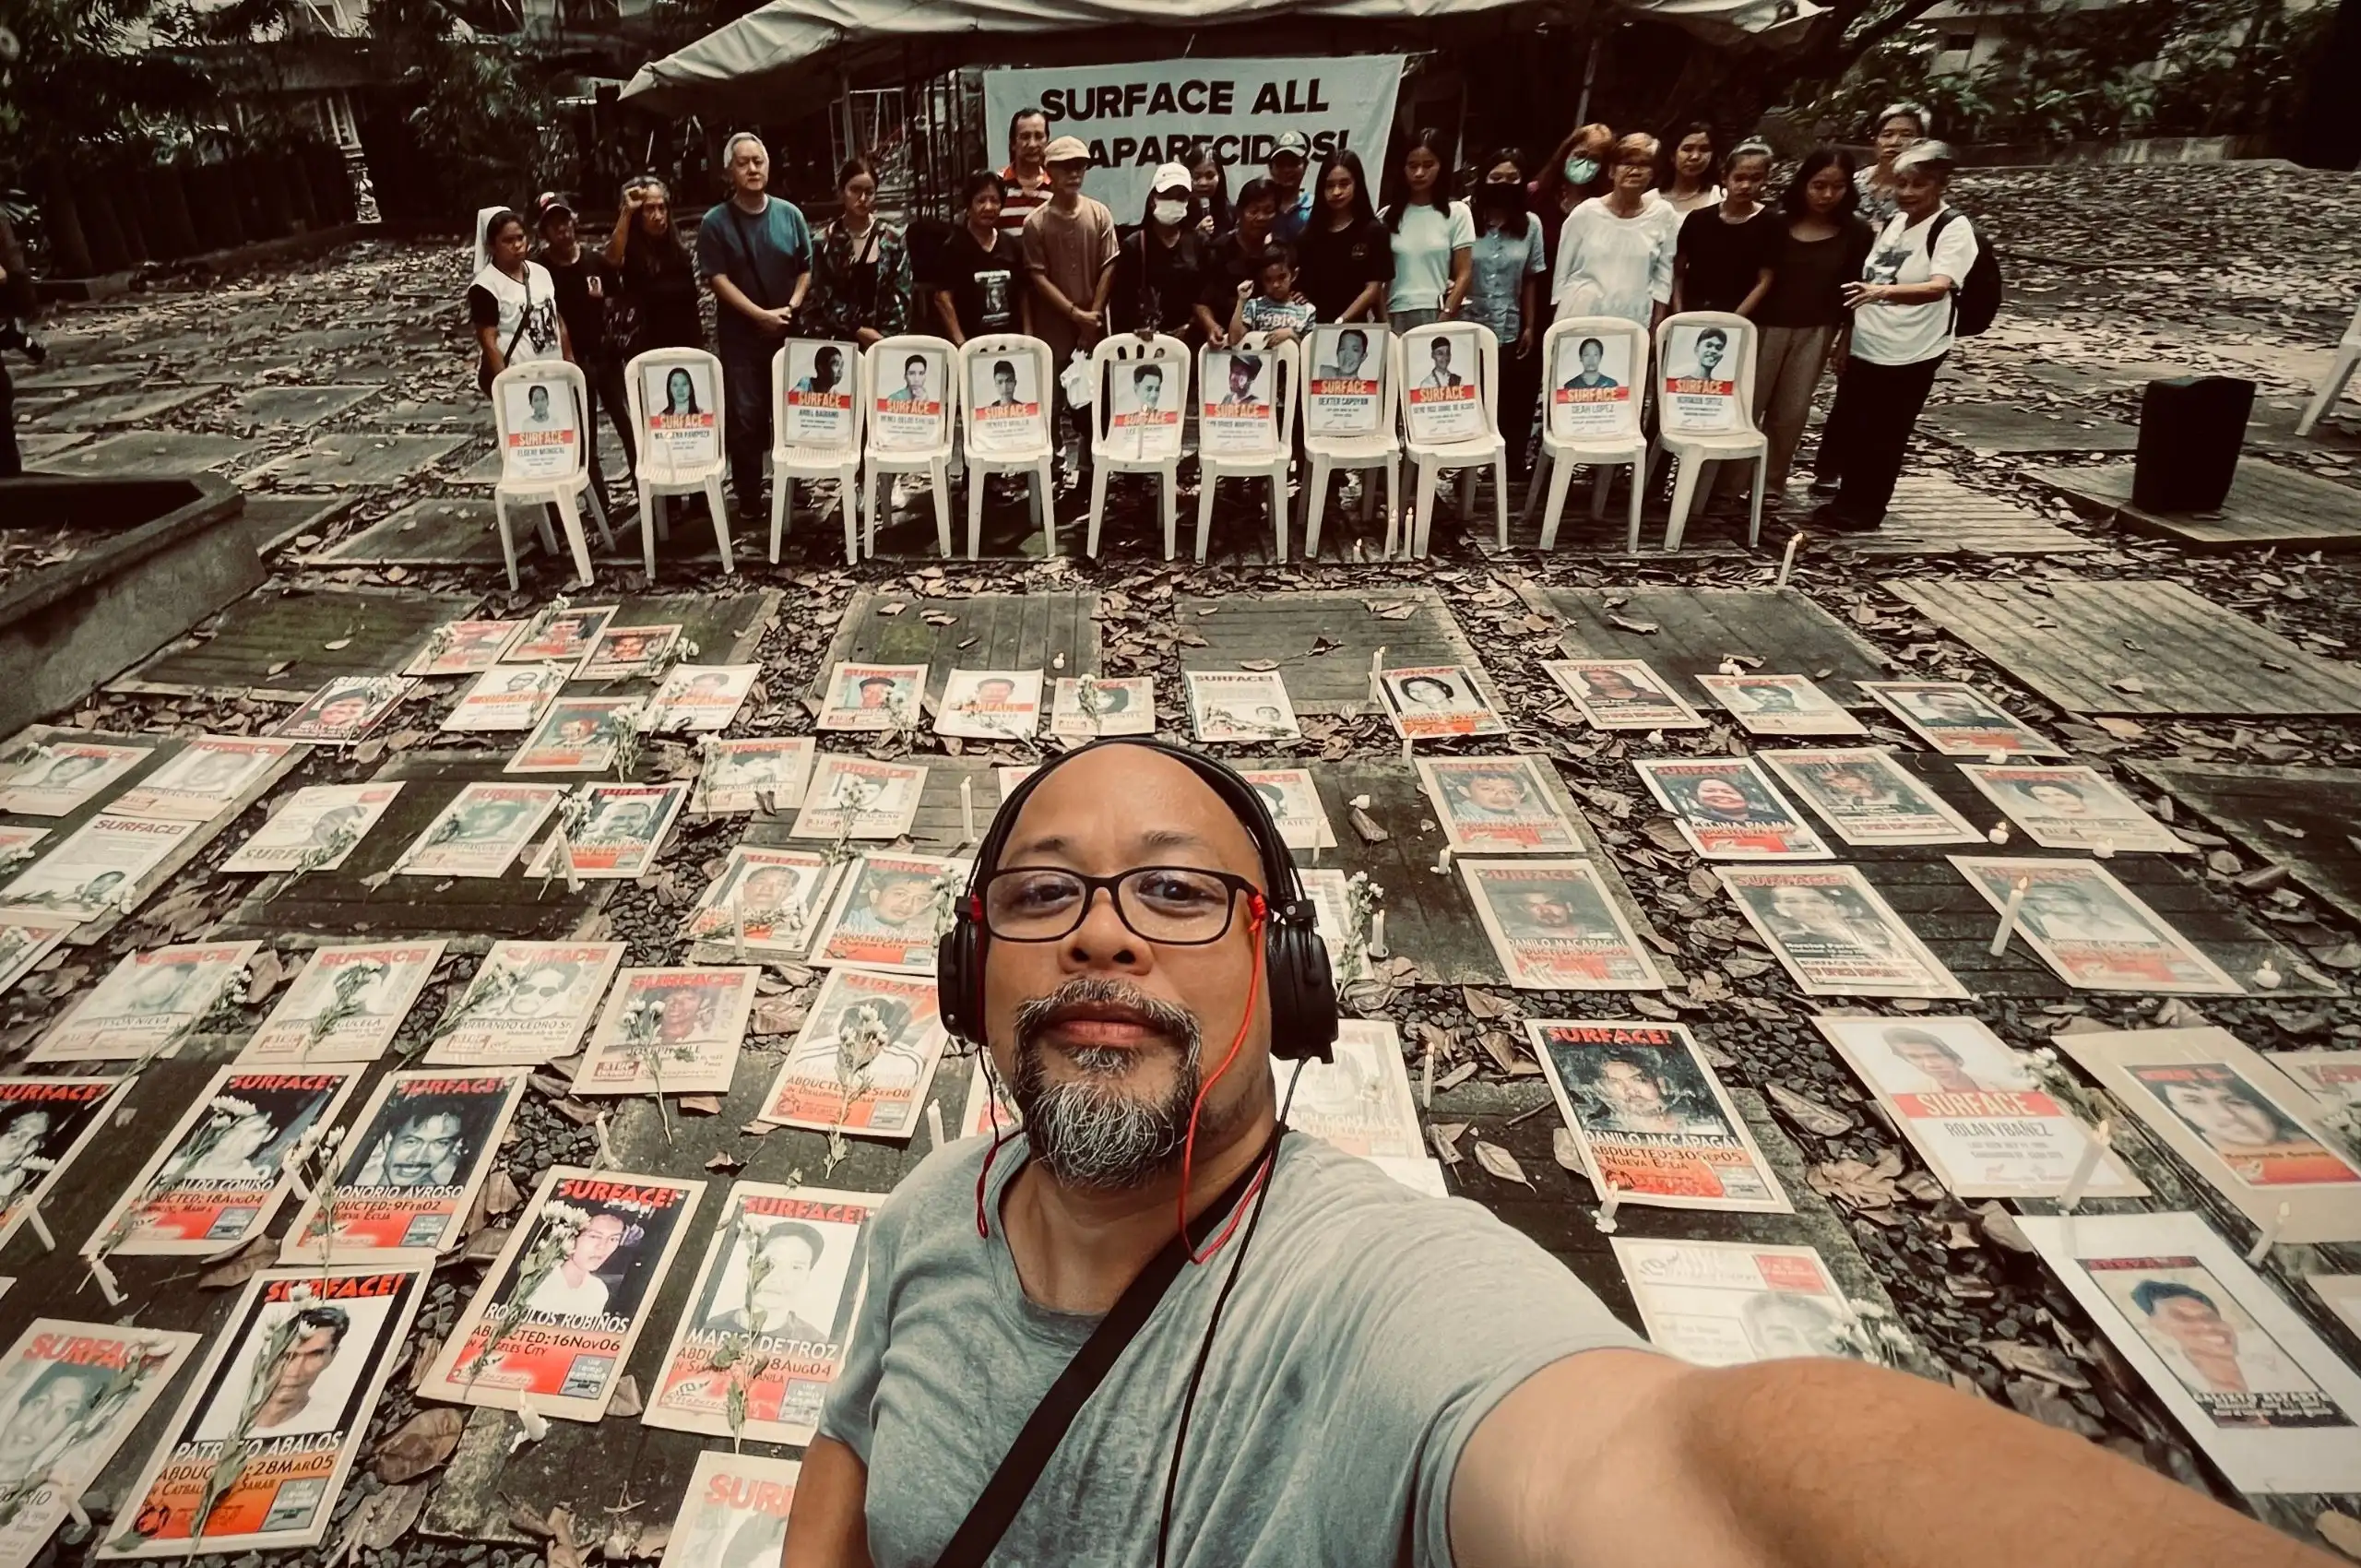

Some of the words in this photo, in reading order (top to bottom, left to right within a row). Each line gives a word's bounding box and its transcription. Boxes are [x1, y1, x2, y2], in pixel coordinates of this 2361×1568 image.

[1040, 79, 1235, 122] SURFACE
[1251, 77, 1330, 117] ALL
[1321, 380, 1368, 394] SURFACE
[1676, 378, 1724, 394] SURFACE
[798, 393, 841, 409] SURFACE
[1420, 386, 1465, 403] SURFACE
[1569, 387, 1618, 403] SURFACE
[886, 399, 930, 415] SURFACE
[984, 404, 1028, 419] SURFACE
[1215, 404, 1260, 418] SURFACE
[659, 414, 704, 429] SURFACE
[518, 431, 564, 445] SURFACE
[520, 1021, 555, 1029] CEDRO
[1547, 1027, 1672, 1046] SURFACE!
[229, 1075, 339, 1094] SURFACE!
[397, 1077, 509, 1096] SURFACE!
[1917, 1092, 2037, 1116] SURFACE
[1944, 1123, 1995, 1137] ROLAN
[1584, 1130, 1641, 1146] DANILO
[1645, 1133, 1744, 1151] MACAPAGAL
[1606, 1156, 1648, 1168] NUEVA
[219, 1178, 275, 1193] COMISO
[333, 1184, 401, 1199] HONORIO
[404, 1184, 465, 1199] AYROSO
[558, 1180, 677, 1208] SURFACE!
[744, 1196, 866, 1225] SURFACE!
[559, 1311, 631, 1334] ROBIÑOS
[524, 1343, 549, 1357] CITY
[758, 1335, 840, 1361] DETROZ
[758, 1372, 785, 1384] ANILA
[266, 1430, 347, 1458] ABALOS
